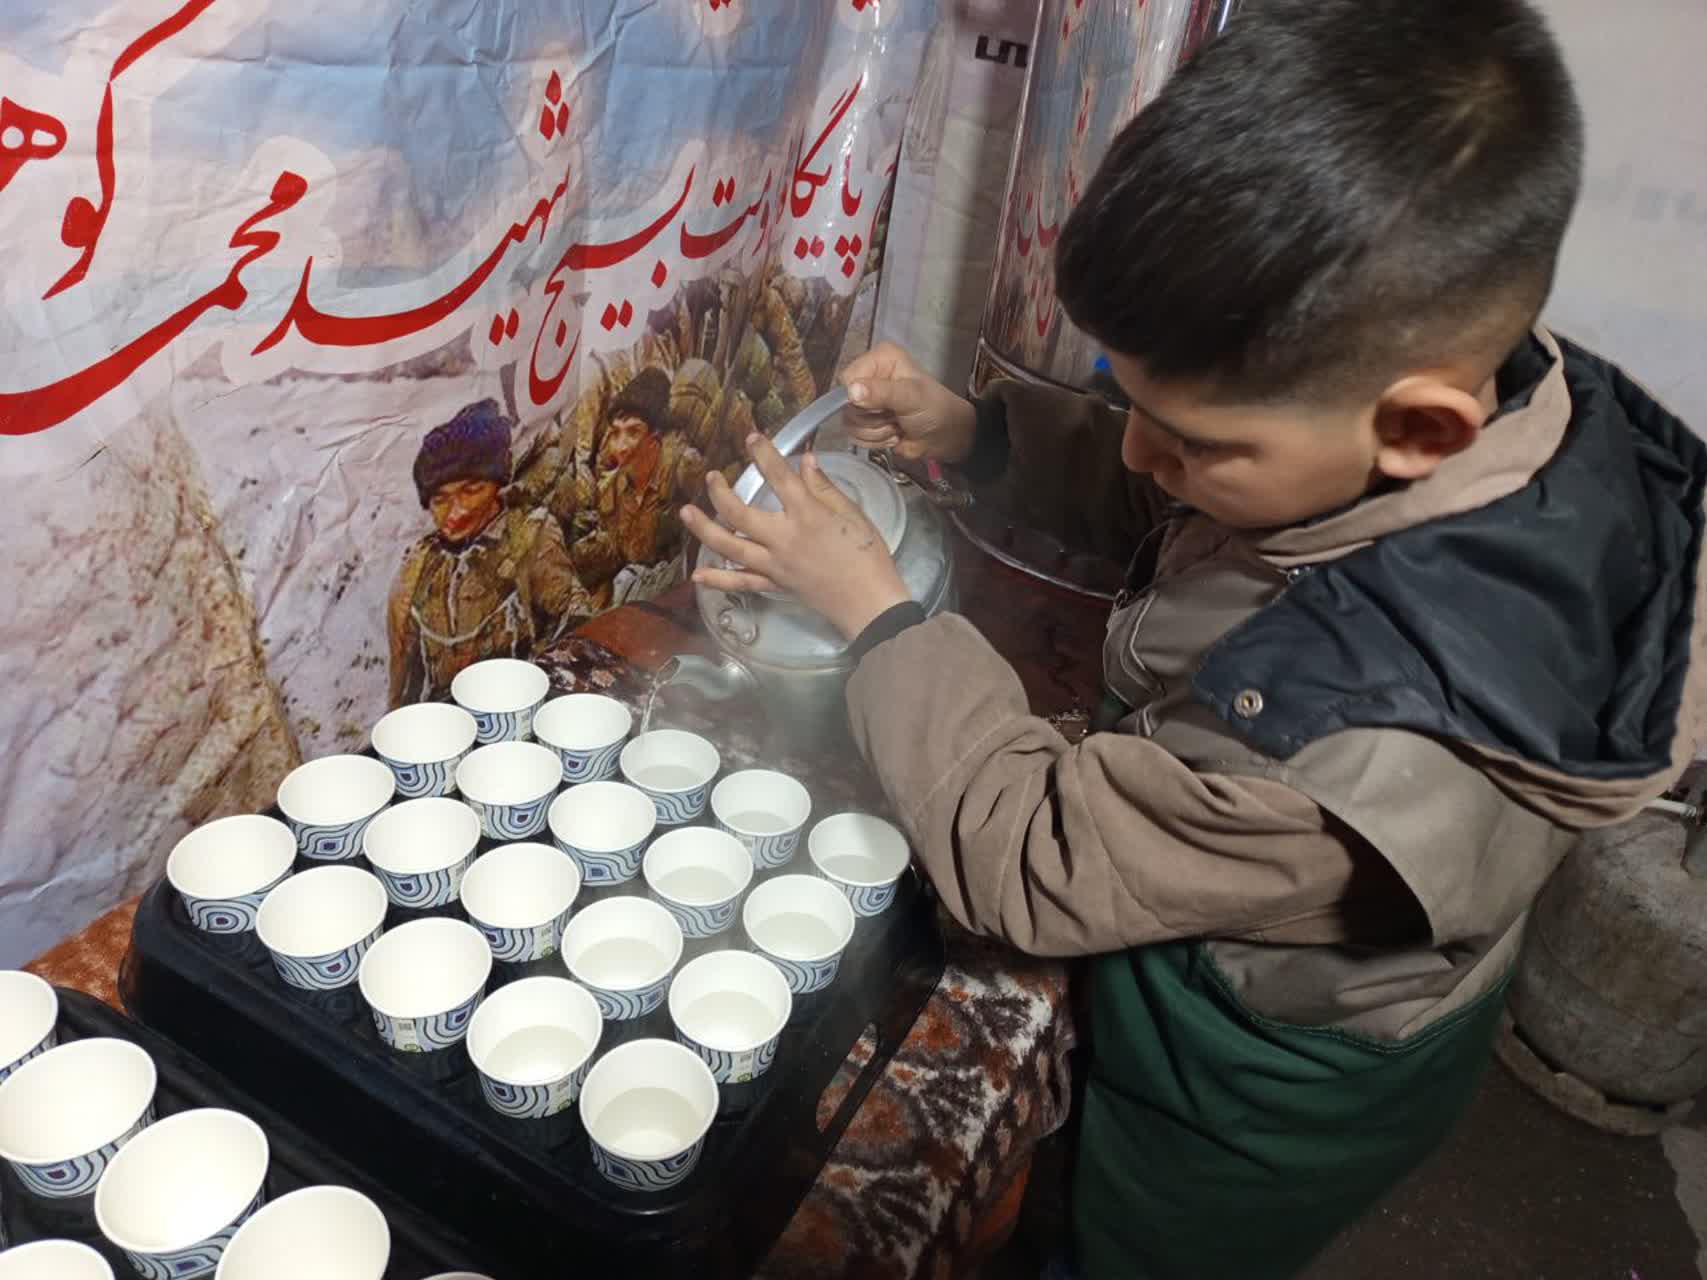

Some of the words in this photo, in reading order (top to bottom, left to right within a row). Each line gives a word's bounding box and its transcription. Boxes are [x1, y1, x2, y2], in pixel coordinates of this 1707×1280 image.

[250, 69, 570, 356] شهید
[528, 162, 696, 406] بسیج
[789, 73, 864, 279] پایگا
